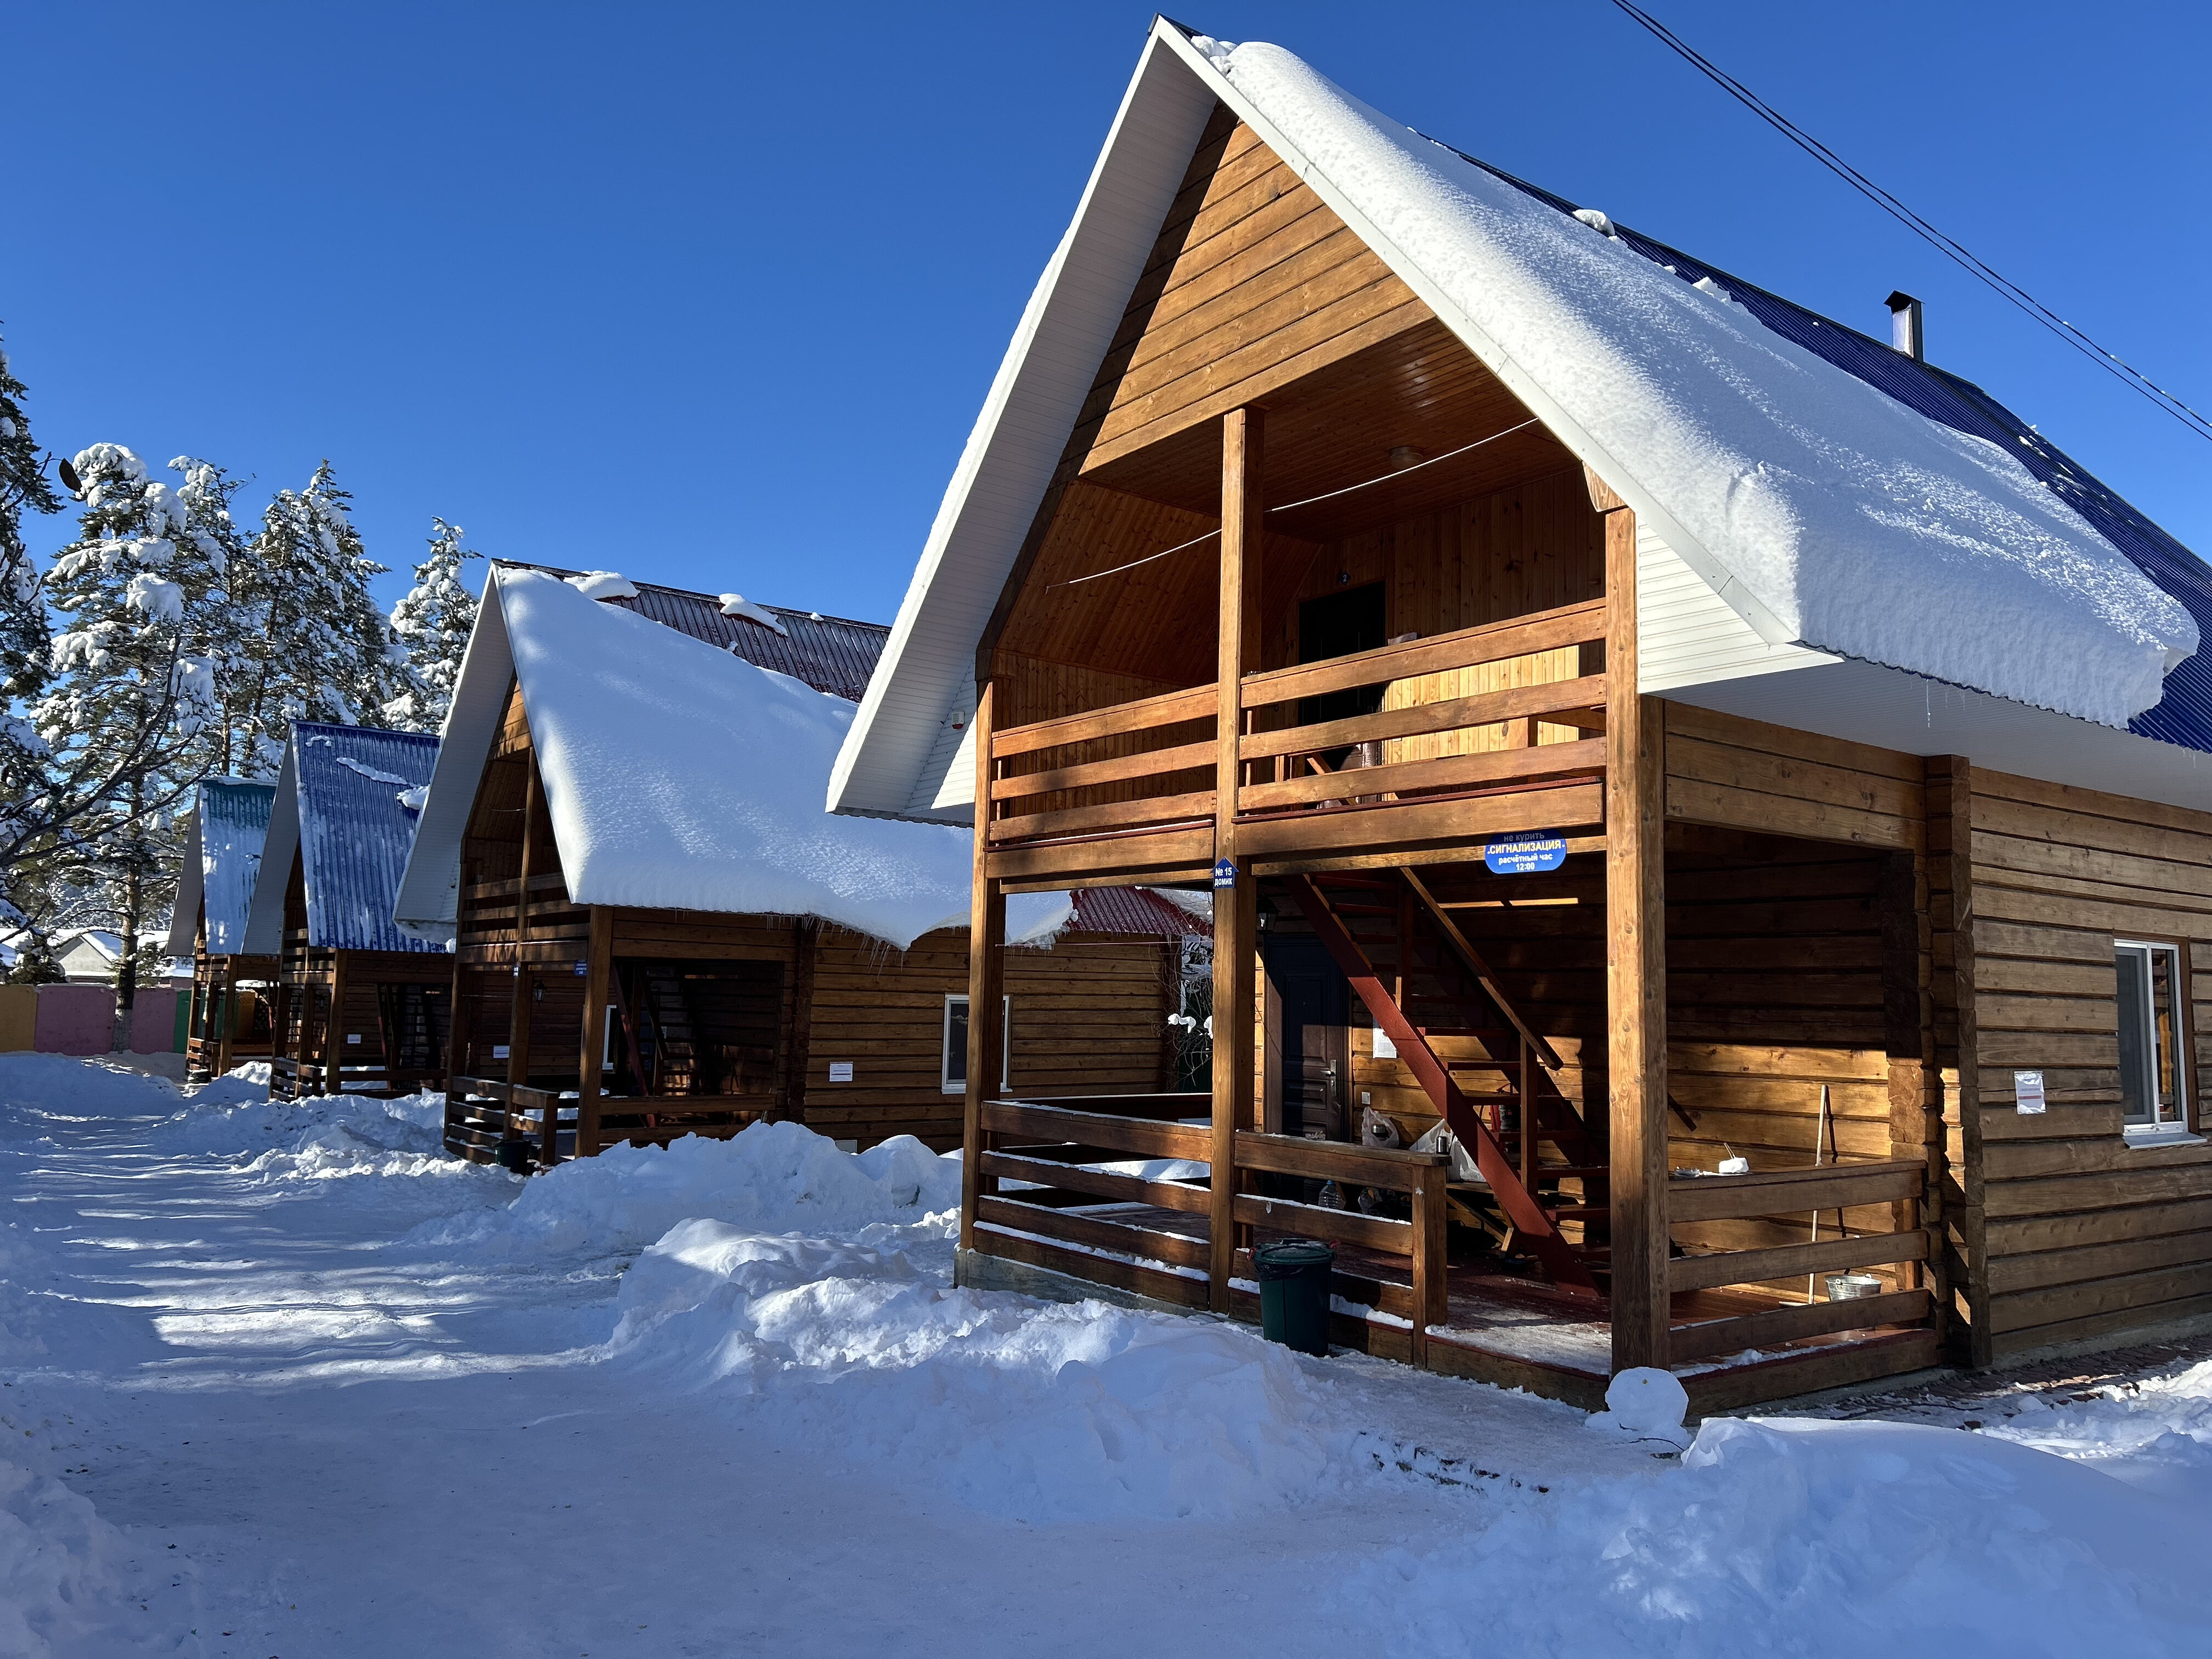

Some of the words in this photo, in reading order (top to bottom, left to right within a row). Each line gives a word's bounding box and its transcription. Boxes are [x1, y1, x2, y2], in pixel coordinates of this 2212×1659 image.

[1516, 832, 1545, 843] курить
[1498, 854, 1538, 866] расчётный
[1224, 867, 1232, 876] 15
[1516, 862, 1535, 871] 12:00
